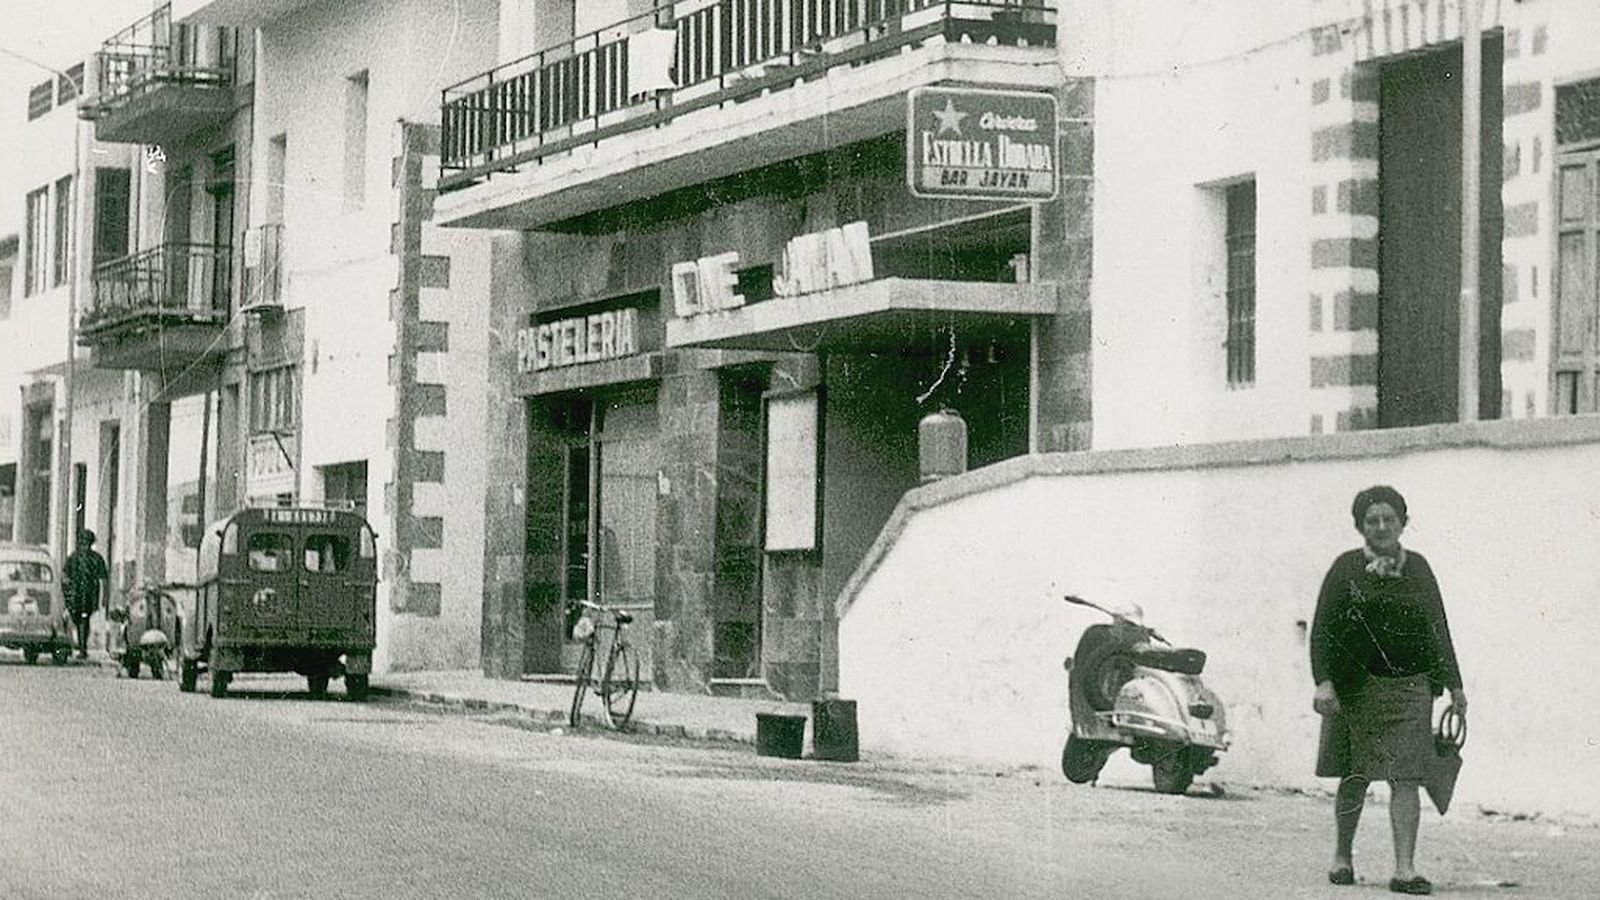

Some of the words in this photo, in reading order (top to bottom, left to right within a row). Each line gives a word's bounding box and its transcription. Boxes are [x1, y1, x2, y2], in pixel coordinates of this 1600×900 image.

[941, 170, 967, 186] BAR
[979, 171, 1029, 188] JAYAN
[518, 308, 639, 373] PASTELERIA
